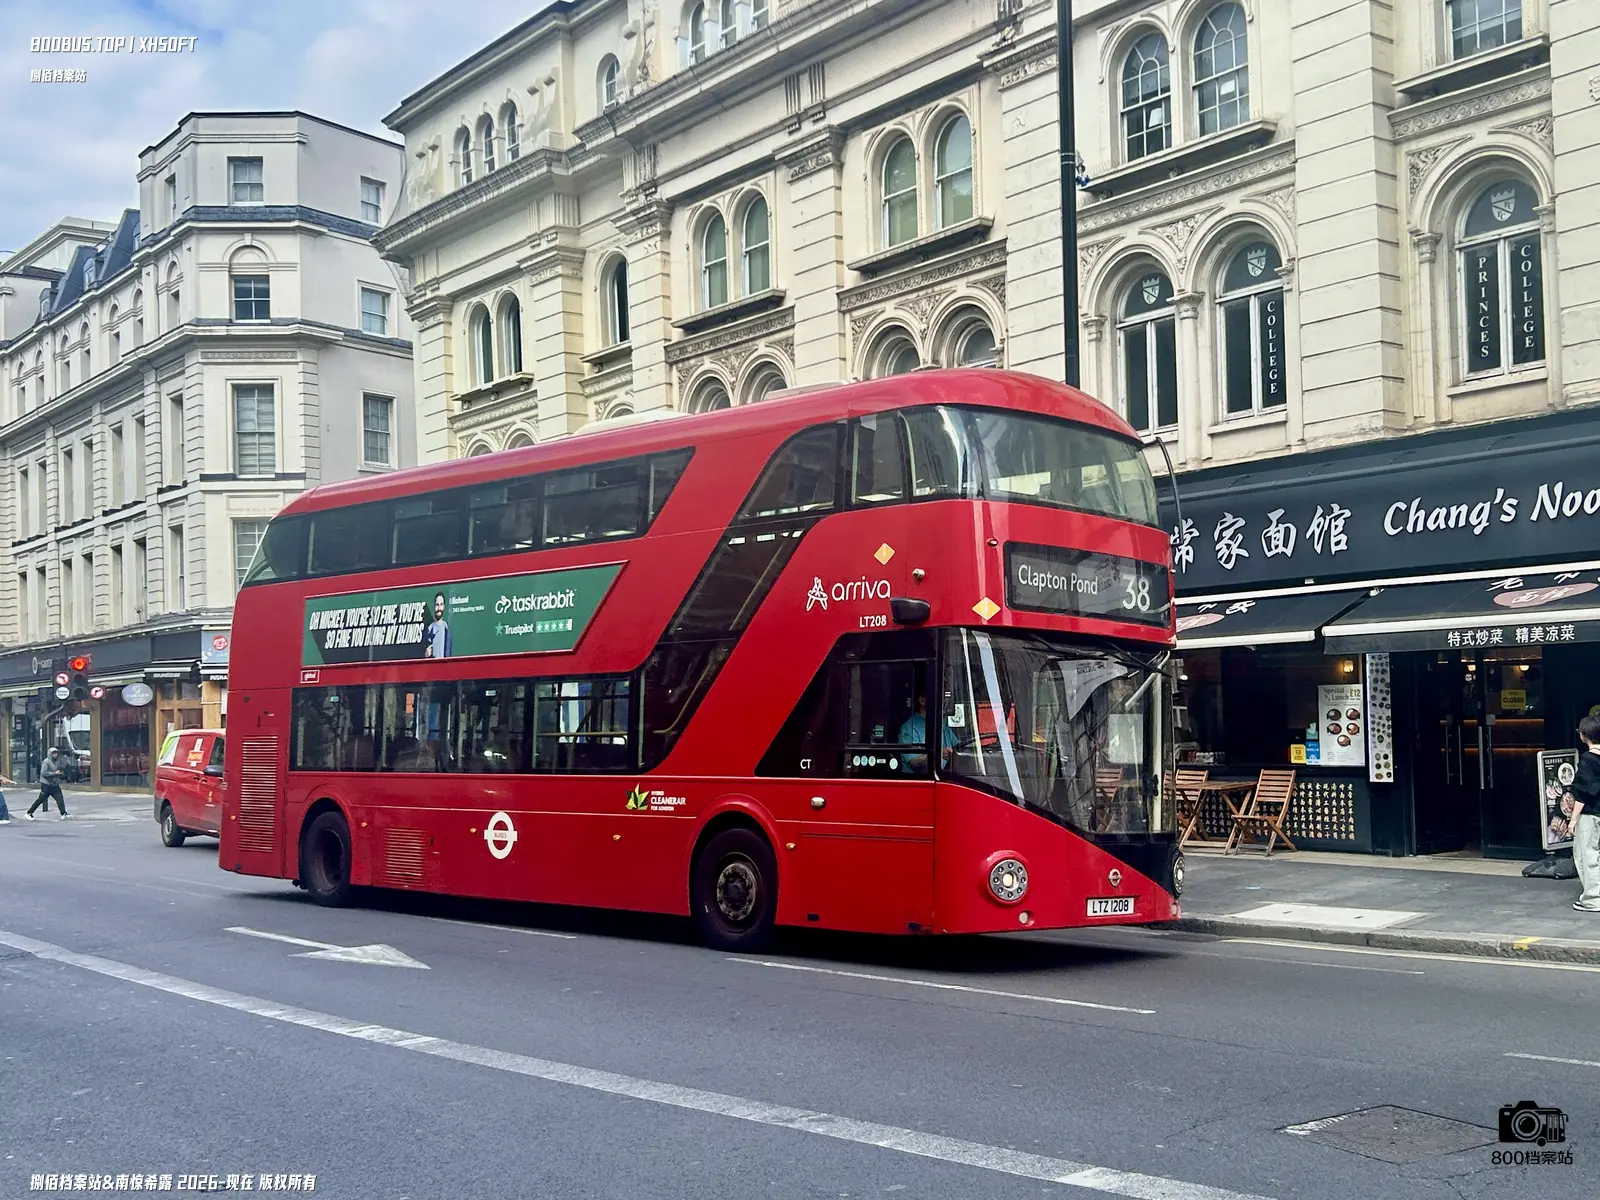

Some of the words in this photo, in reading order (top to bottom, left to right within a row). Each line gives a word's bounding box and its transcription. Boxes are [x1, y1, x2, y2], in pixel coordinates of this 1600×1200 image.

[1478, 257, 1489, 358] PRINCES
[1520, 244, 1535, 348] COLLEGE
[1267, 301, 1278, 394] COLLEGE
[1383, 488, 1519, 536] Chang's
[1170, 503, 1352, 574] 常家面馆
[831, 576, 891, 601] arriva
[1018, 564, 1067, 592] Clapton
[1070, 572, 1098, 595] Pond
[512, 588, 575, 612] taskrabbit
[1122, 574, 1150, 612] 38
[310, 611, 321, 630] OH
[319, 609, 346, 629] MICKEY,
[346, 607, 370, 627] YOU'RE
[370, 605, 381, 625] SO
[380, 604, 398, 626] FINE,
[399, 602, 426, 623] YOU'RE
[859, 615, 887, 628] LT208
[325, 630, 336, 649] SO
[334, 629, 352, 648] FINE
[351, 628, 366, 647] YOU
[385, 624, 399, 645] MY
[397, 623, 425, 644] BLINDS
[505, 624, 534, 635] Trustpilot
[1447, 628, 1503, 647] 特式炒菜
[1515, 624, 1576, 643] 精美凉菜
[1350, 688, 1361, 698] £12
[800, 759, 811, 769] CT
[1092, 901, 1108, 913] LTZ
[1110, 900, 1128, 912] 1208
